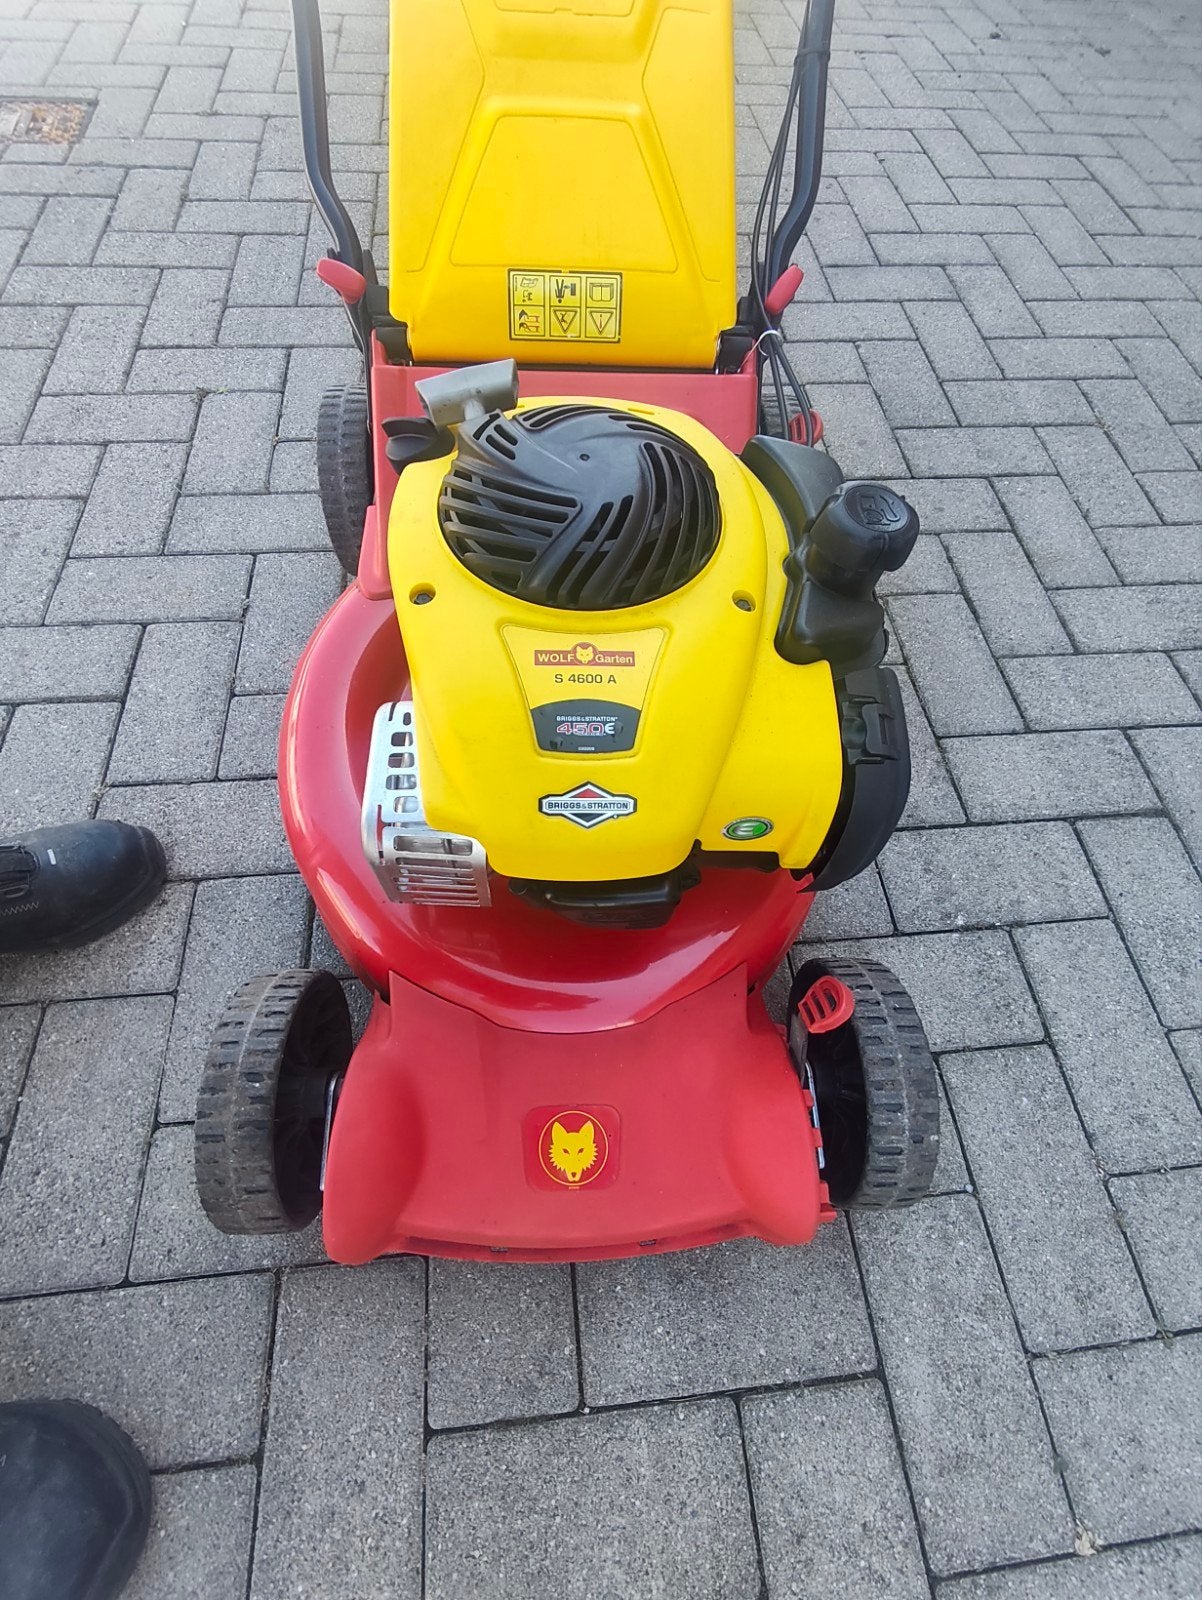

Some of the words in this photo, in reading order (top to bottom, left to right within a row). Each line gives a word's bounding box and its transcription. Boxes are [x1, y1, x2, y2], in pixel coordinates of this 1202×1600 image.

[537, 653, 575, 663] WOLF
[595, 654, 633, 664] Garten
[554, 673, 564, 684] S
[568, 673, 603, 684] 4600
[607, 674, 617, 684] A
